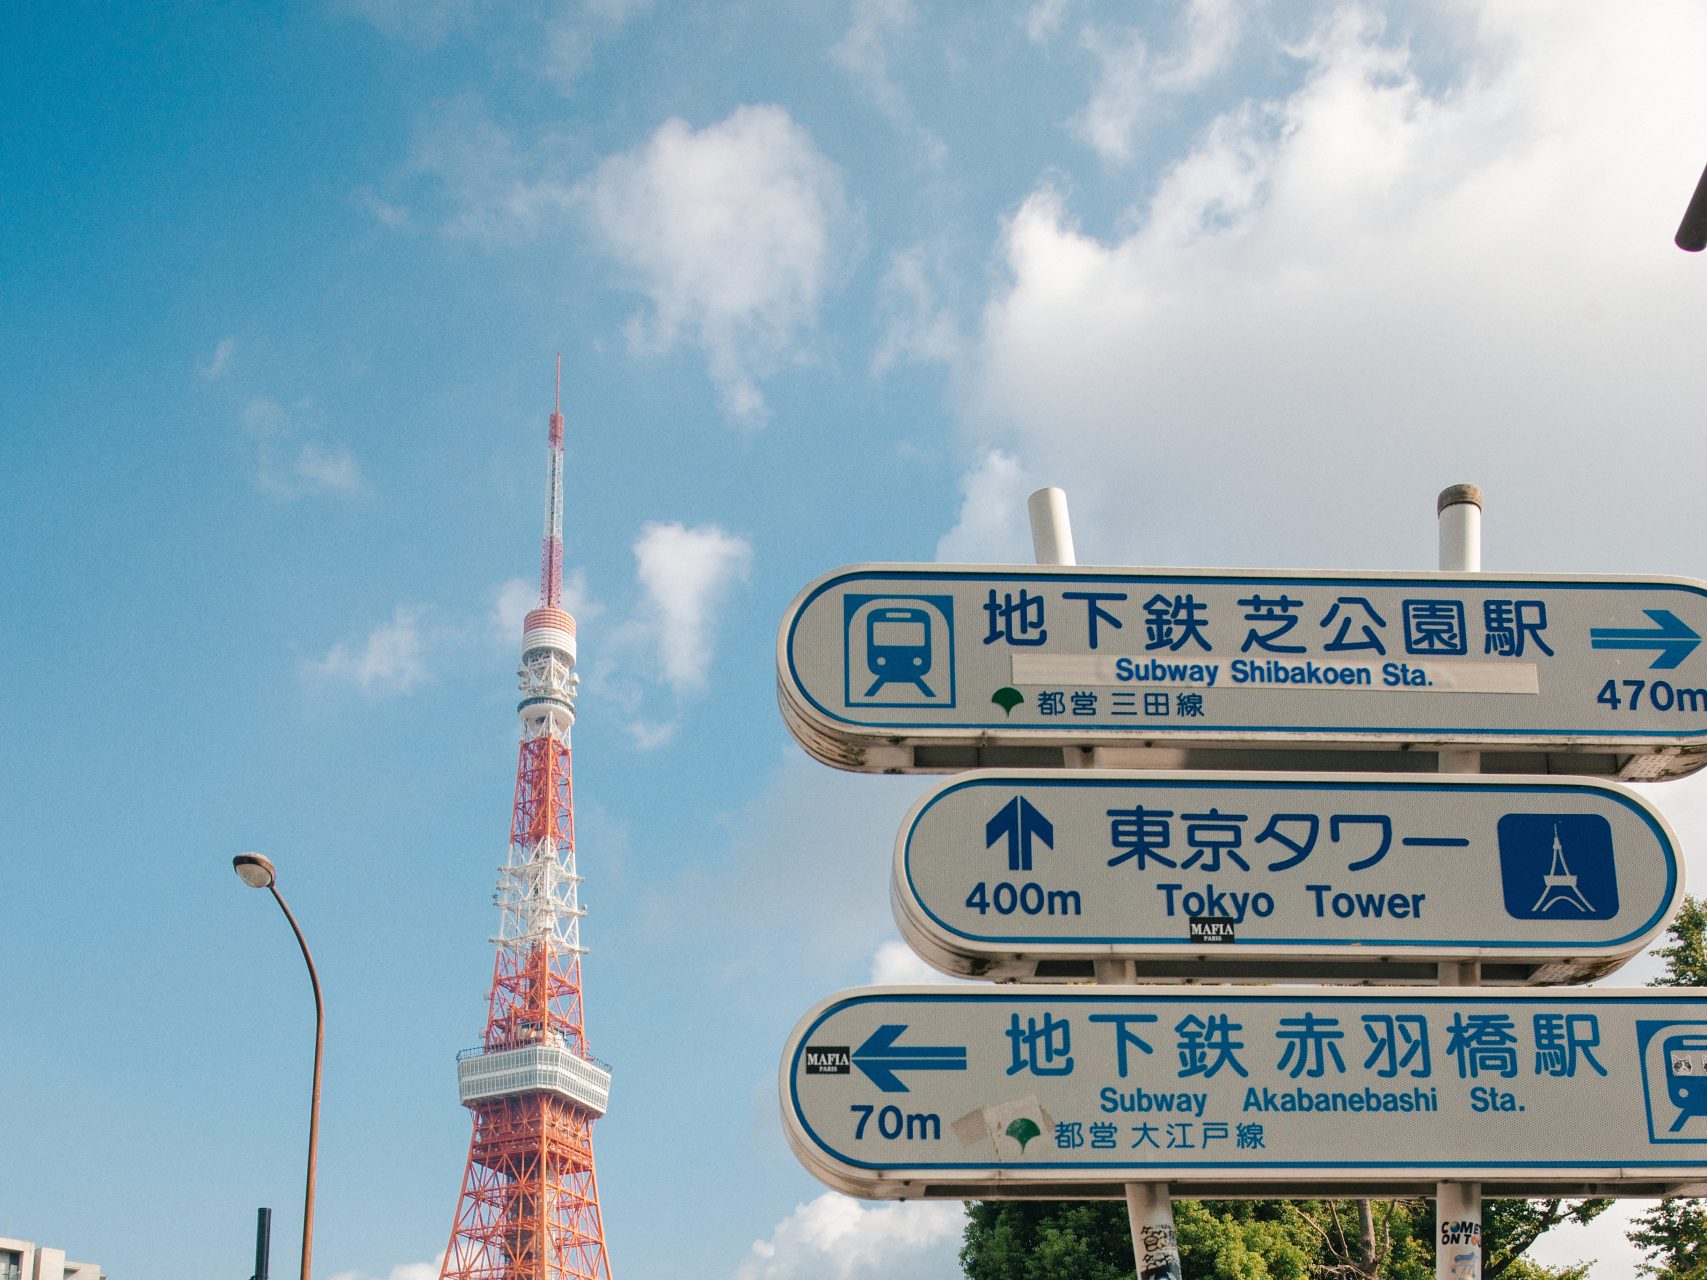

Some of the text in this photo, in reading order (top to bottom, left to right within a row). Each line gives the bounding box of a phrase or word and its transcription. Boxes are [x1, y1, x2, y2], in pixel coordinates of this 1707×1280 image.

[1116, 658, 1433, 686] Subway Shibakoen Sta.
[1597, 680, 1707, 712] 470m
[1106, 804, 1470, 873] 東京タワー
[965, 881, 1082, 916] 400m
[1156, 883, 1426, 924] Tokyo Tower
[1191, 922, 1234, 936] MAFIA
[806, 1052, 850, 1066] MAFIA
[1100, 1086, 1526, 1117] Subway Akabanebashi Sta.
[850, 1104, 941, 1140] 70m
[1441, 1234, 1460, 1246] ON
